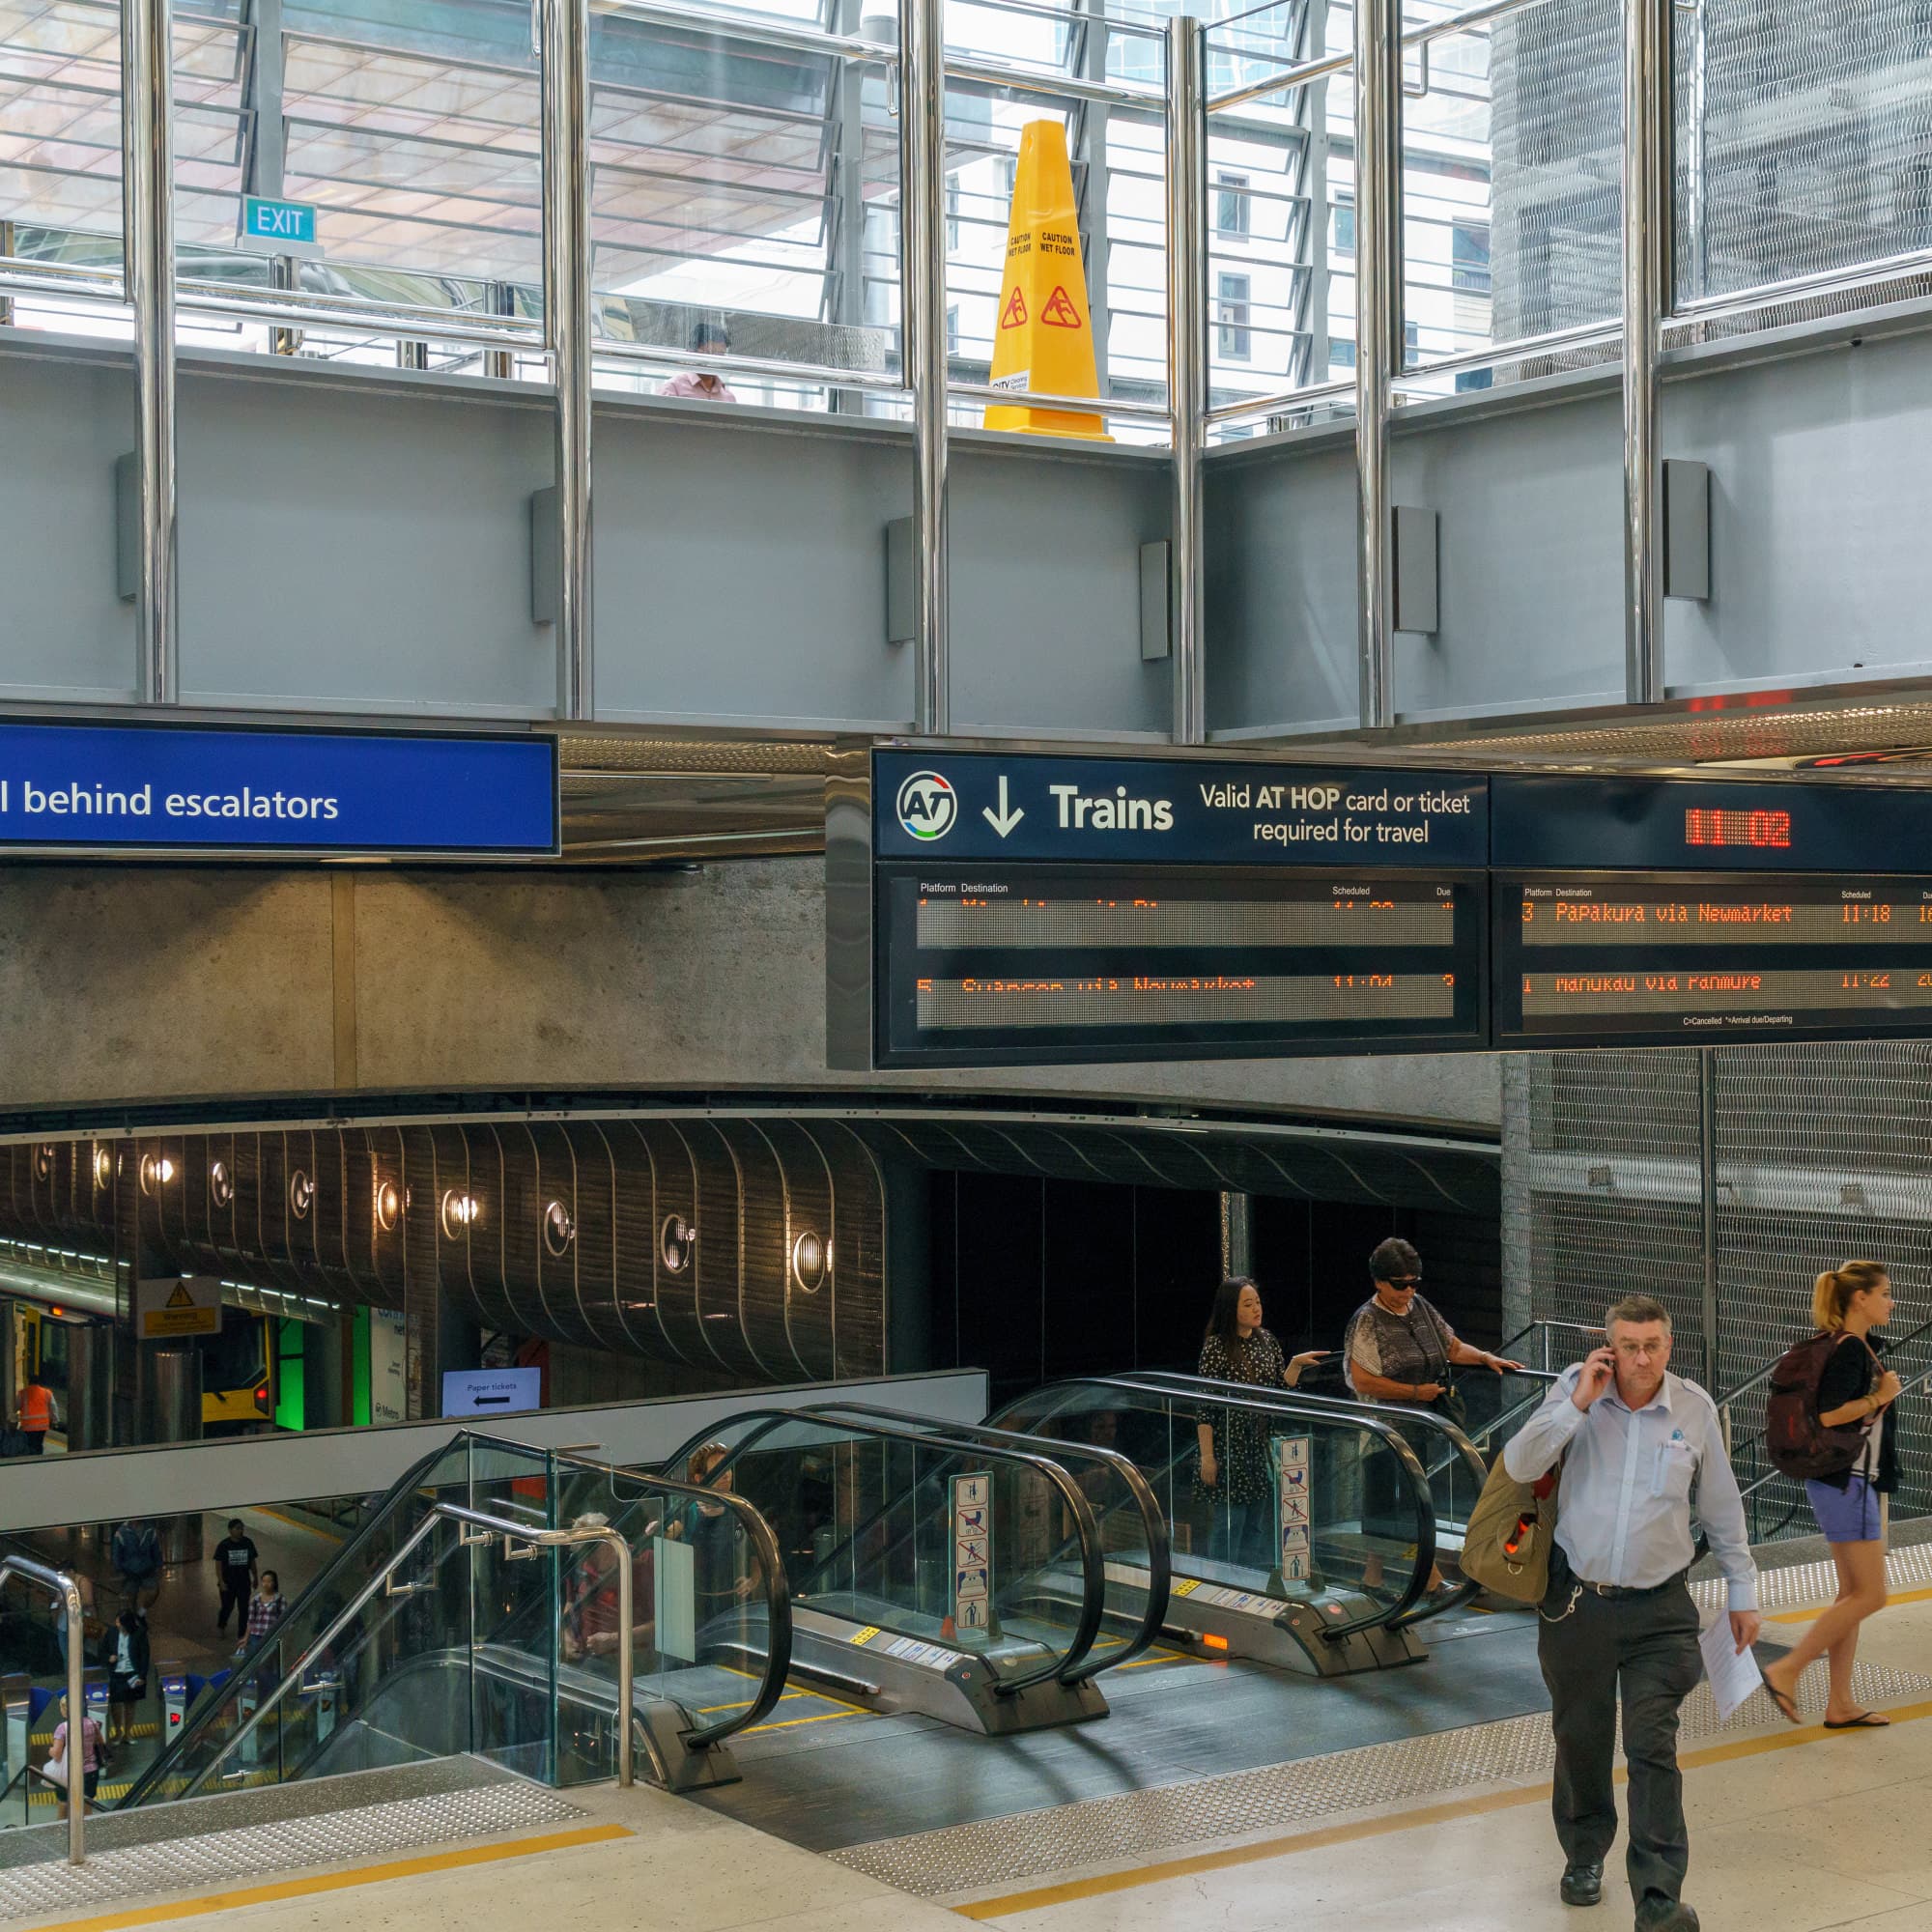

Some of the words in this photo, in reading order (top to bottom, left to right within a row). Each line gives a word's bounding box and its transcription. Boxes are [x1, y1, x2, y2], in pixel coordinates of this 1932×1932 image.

[257, 206, 303, 236] EXIT
[1042, 232, 1072, 244] CAUTION
[1040, 243, 1053, 253] WET
[1055, 245, 1074, 255] FLOOR
[24, 781, 151, 815] behind
[165, 787, 338, 819] escalators
[1200, 783, 1250, 809] Valid
[1256, 786, 1285, 810] AT
[1291, 787, 1341, 810] HOP
[1346, 788, 1388, 811] card
[1393, 797, 1413, 812] or
[1418, 790, 1470, 813] ticket
[904, 790, 952, 821] AT
[1049, 784, 1174, 831] Trains
[1253, 818, 1338, 847] required
[1343, 818, 1371, 842] for
[1376, 820, 1429, 843] travel
[921, 883, 956, 893] Platform
[961, 883, 1009, 893] Destination
[1332, 886, 1371, 895] Scheduled
[1436, 887, 1451, 896] Due
[1524, 888, 1552, 896] Platform
[1555, 888, 1592, 896] Destination
[1841, 891, 1871, 899] Scheduled
[1521, 902, 1534, 922] 3
[1555, 902, 1646, 922] Papakura
[1655, 903, 1689, 922] via
[1698, 903, 1794, 923] Newmarket
[1842, 904, 1890, 923] 11:18
[1683, 1016, 1722, 1026] C=Cancelled
[467, 1382, 490, 1394] Paper
[492, 1381, 517, 1391] tickets
